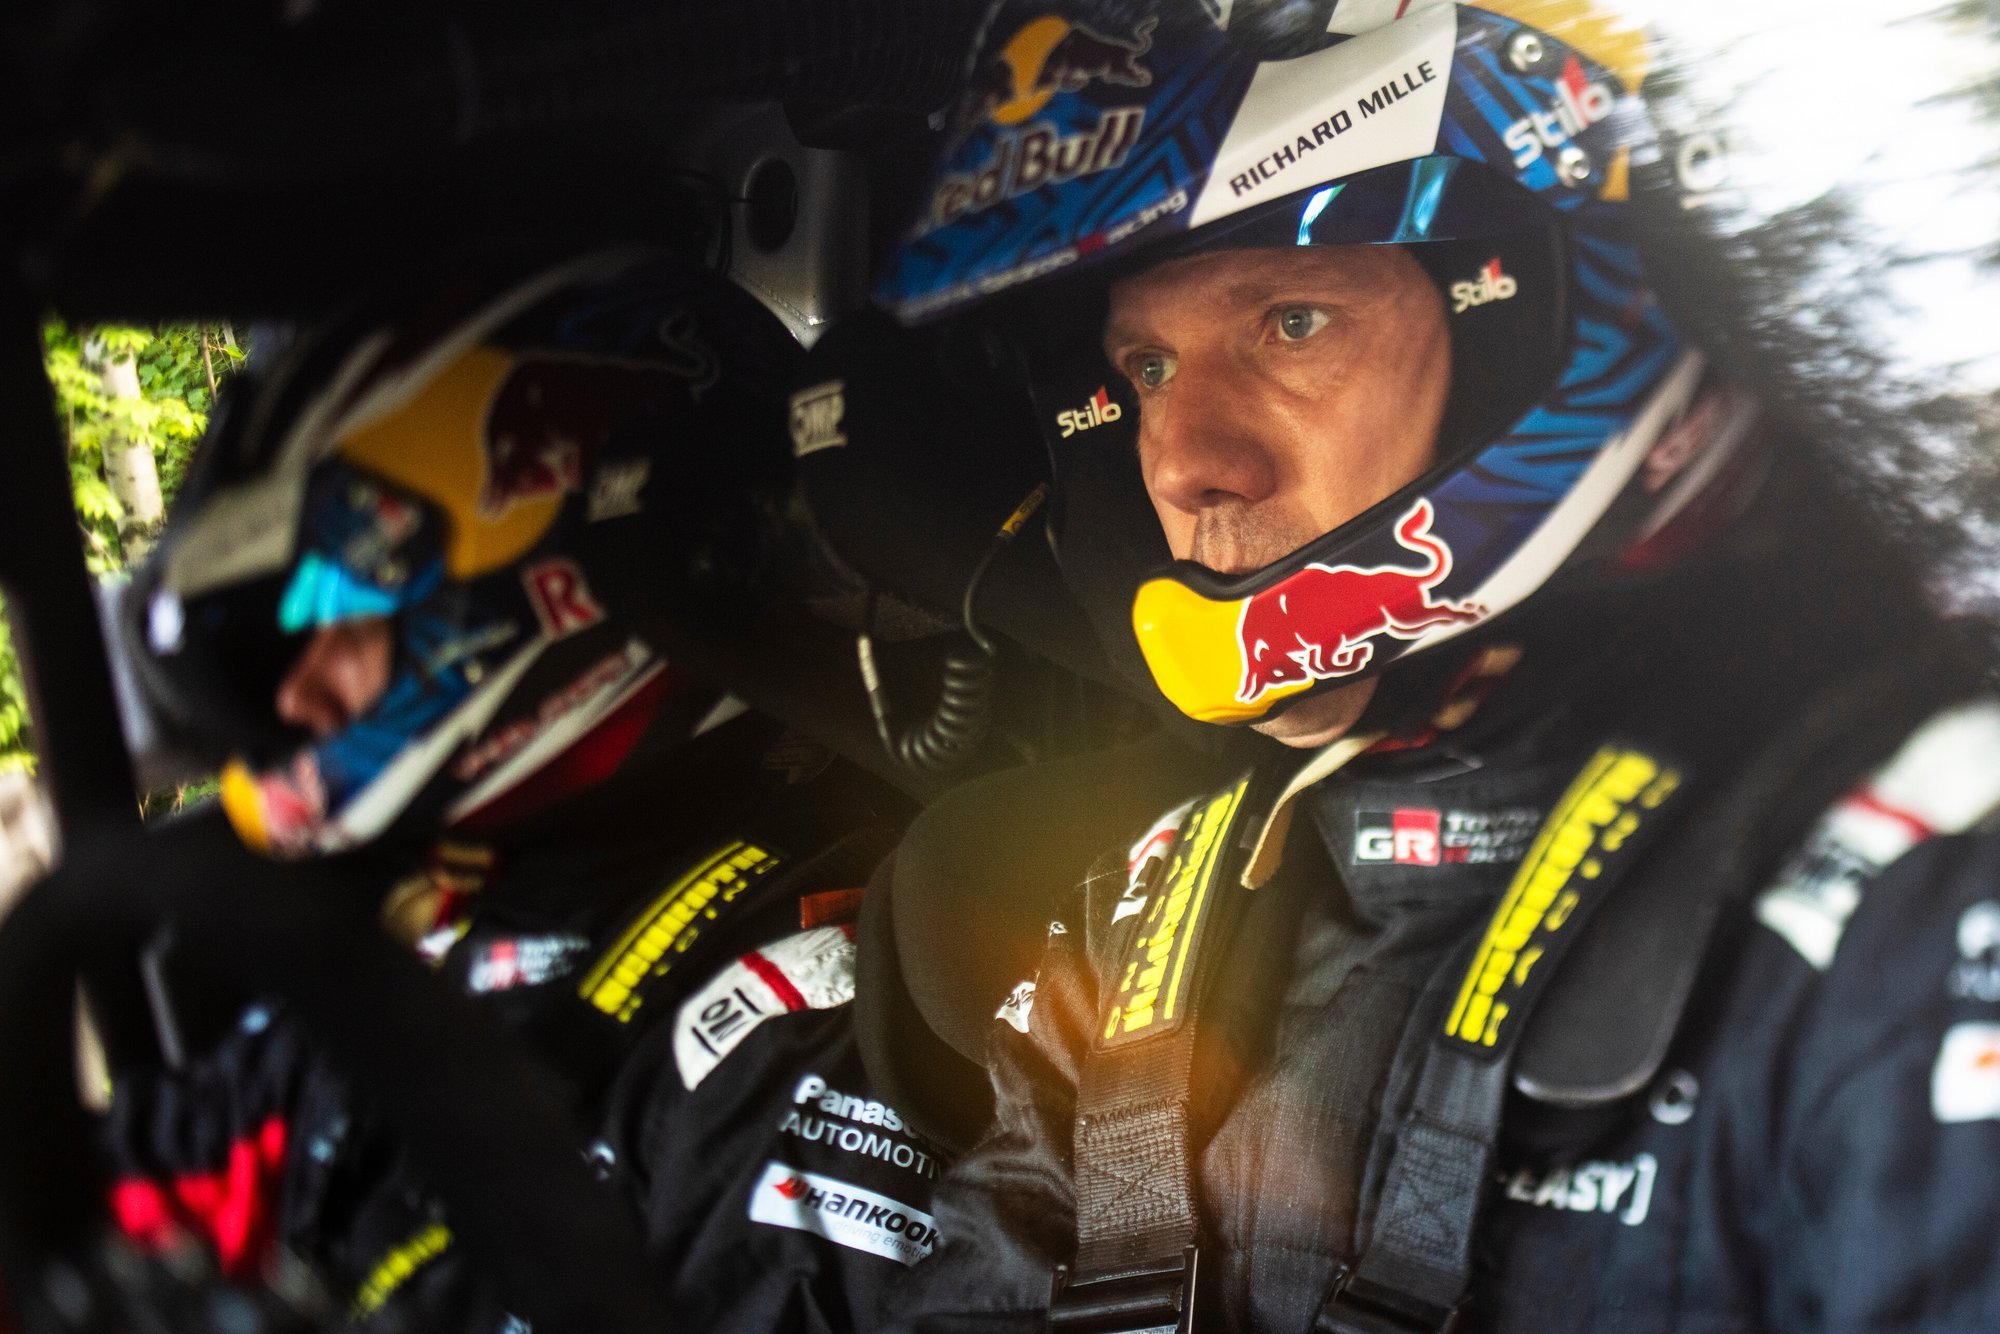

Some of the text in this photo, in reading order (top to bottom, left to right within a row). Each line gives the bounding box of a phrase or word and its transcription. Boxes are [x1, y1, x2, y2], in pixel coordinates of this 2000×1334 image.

[1229, 60, 1437, 197] RICHARD MILLE
[1504, 60, 1614, 169] Stilo
[915, 108, 1146, 236] ed Bull
[1451, 258, 1517, 314] Stilo
[1057, 386, 1121, 438] Stilo
[1356, 827, 1437, 862] GR
[882, 1233, 930, 1263] emotio
